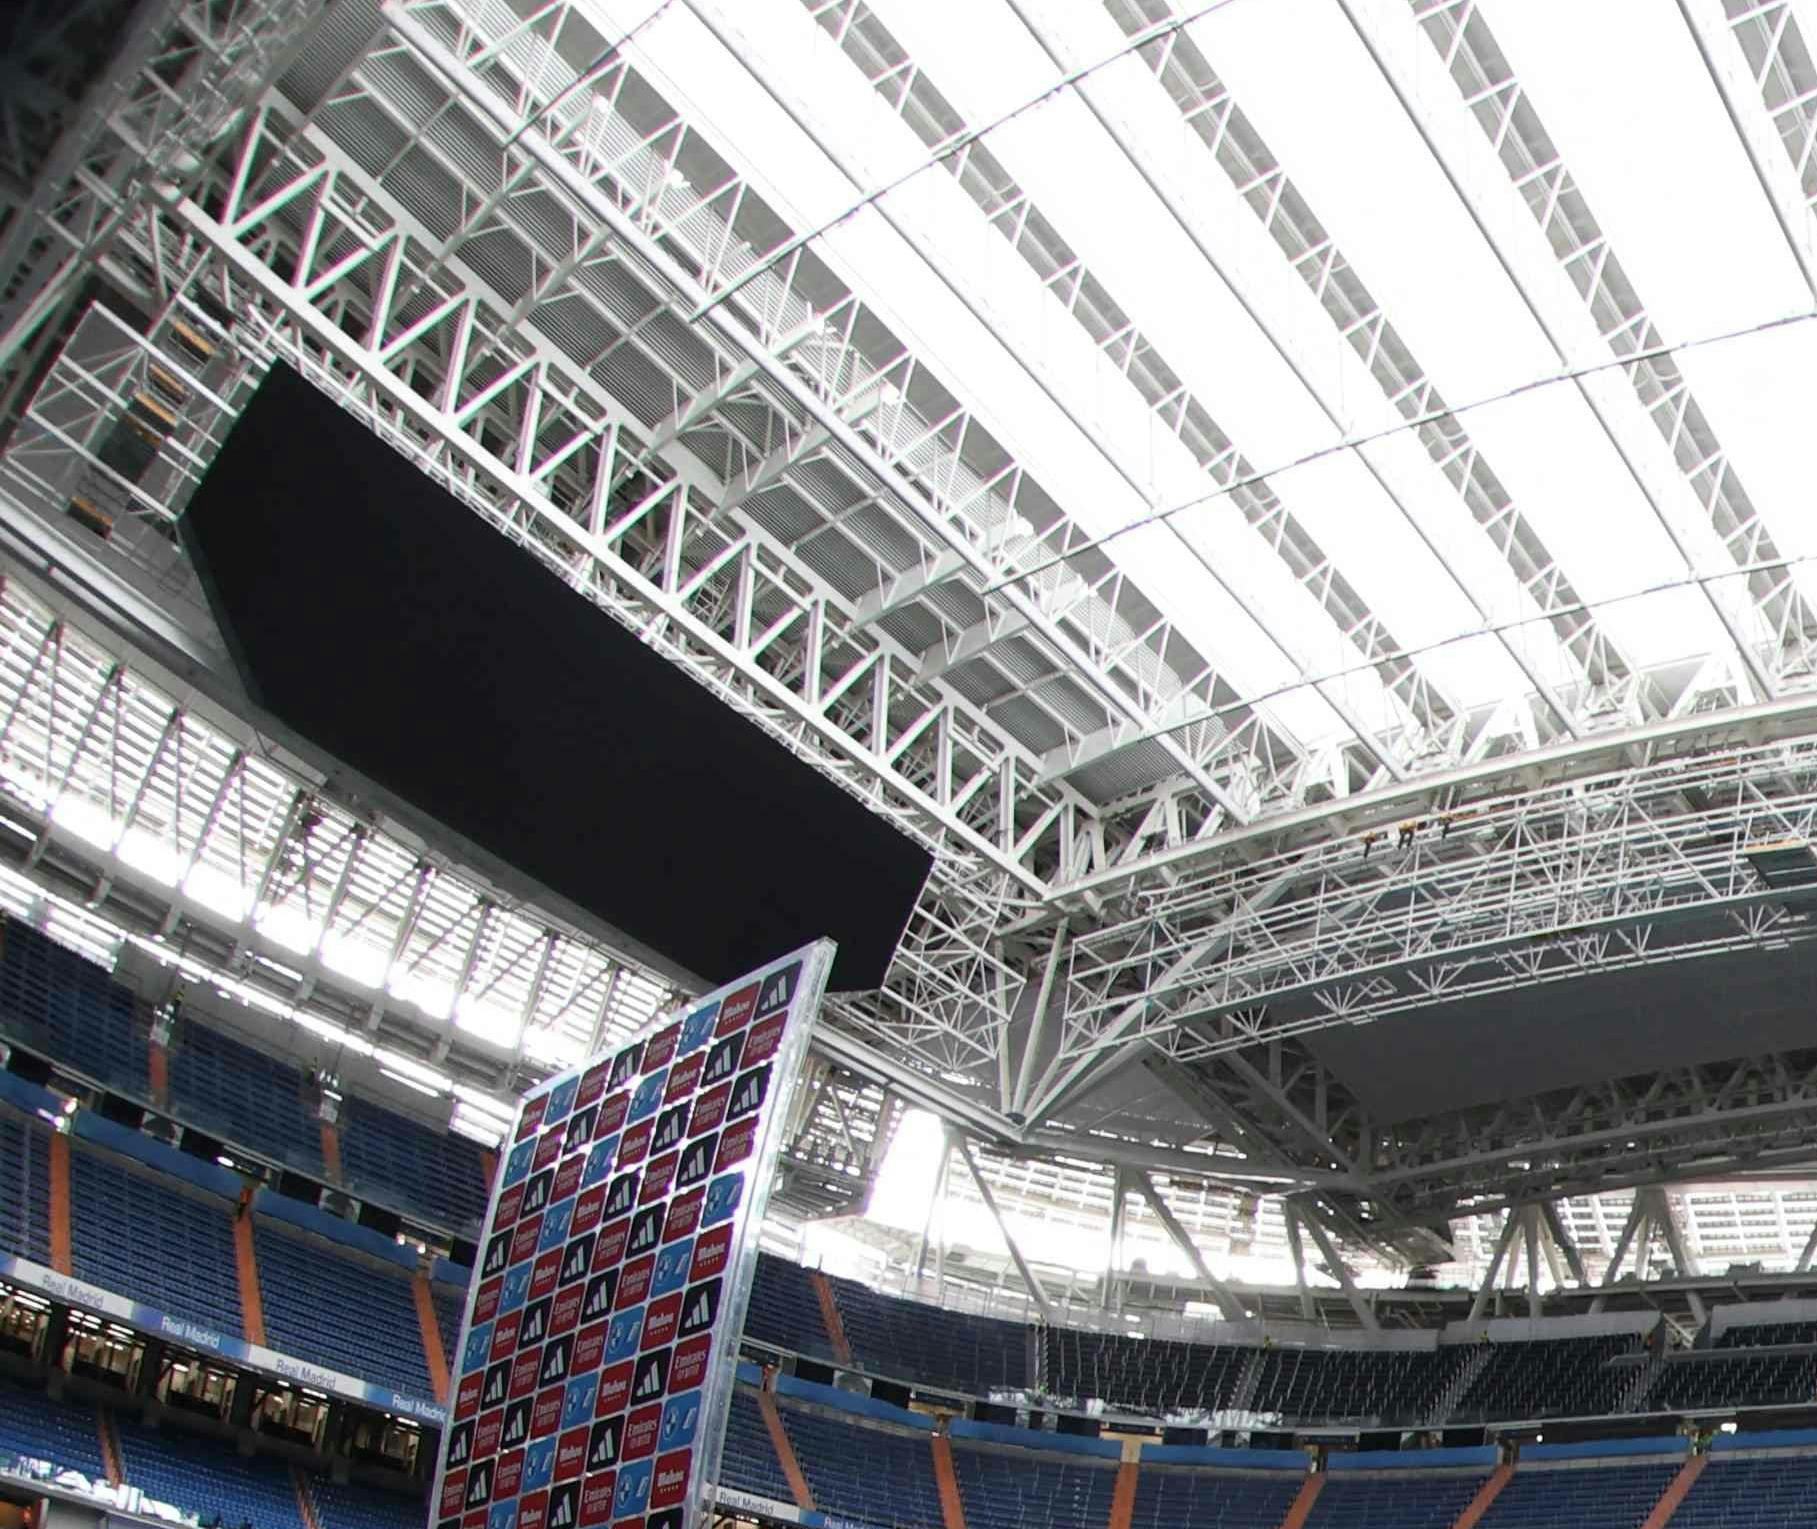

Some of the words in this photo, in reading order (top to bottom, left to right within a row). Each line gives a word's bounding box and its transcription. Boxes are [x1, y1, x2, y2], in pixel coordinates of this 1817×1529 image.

[42, 1274, 65, 1295] Real
[67, 1282, 103, 1308] Madrid
[161, 1316, 182, 1336] Real
[185, 1322, 220, 1348] Madrid
[276, 1358, 298, 1379] Real
[301, 1365, 337, 1389] Madrid
[392, 1394, 414, 1412] Real
[719, 1491, 739, 1506] Real
[741, 1496, 774, 1514] Madrid
